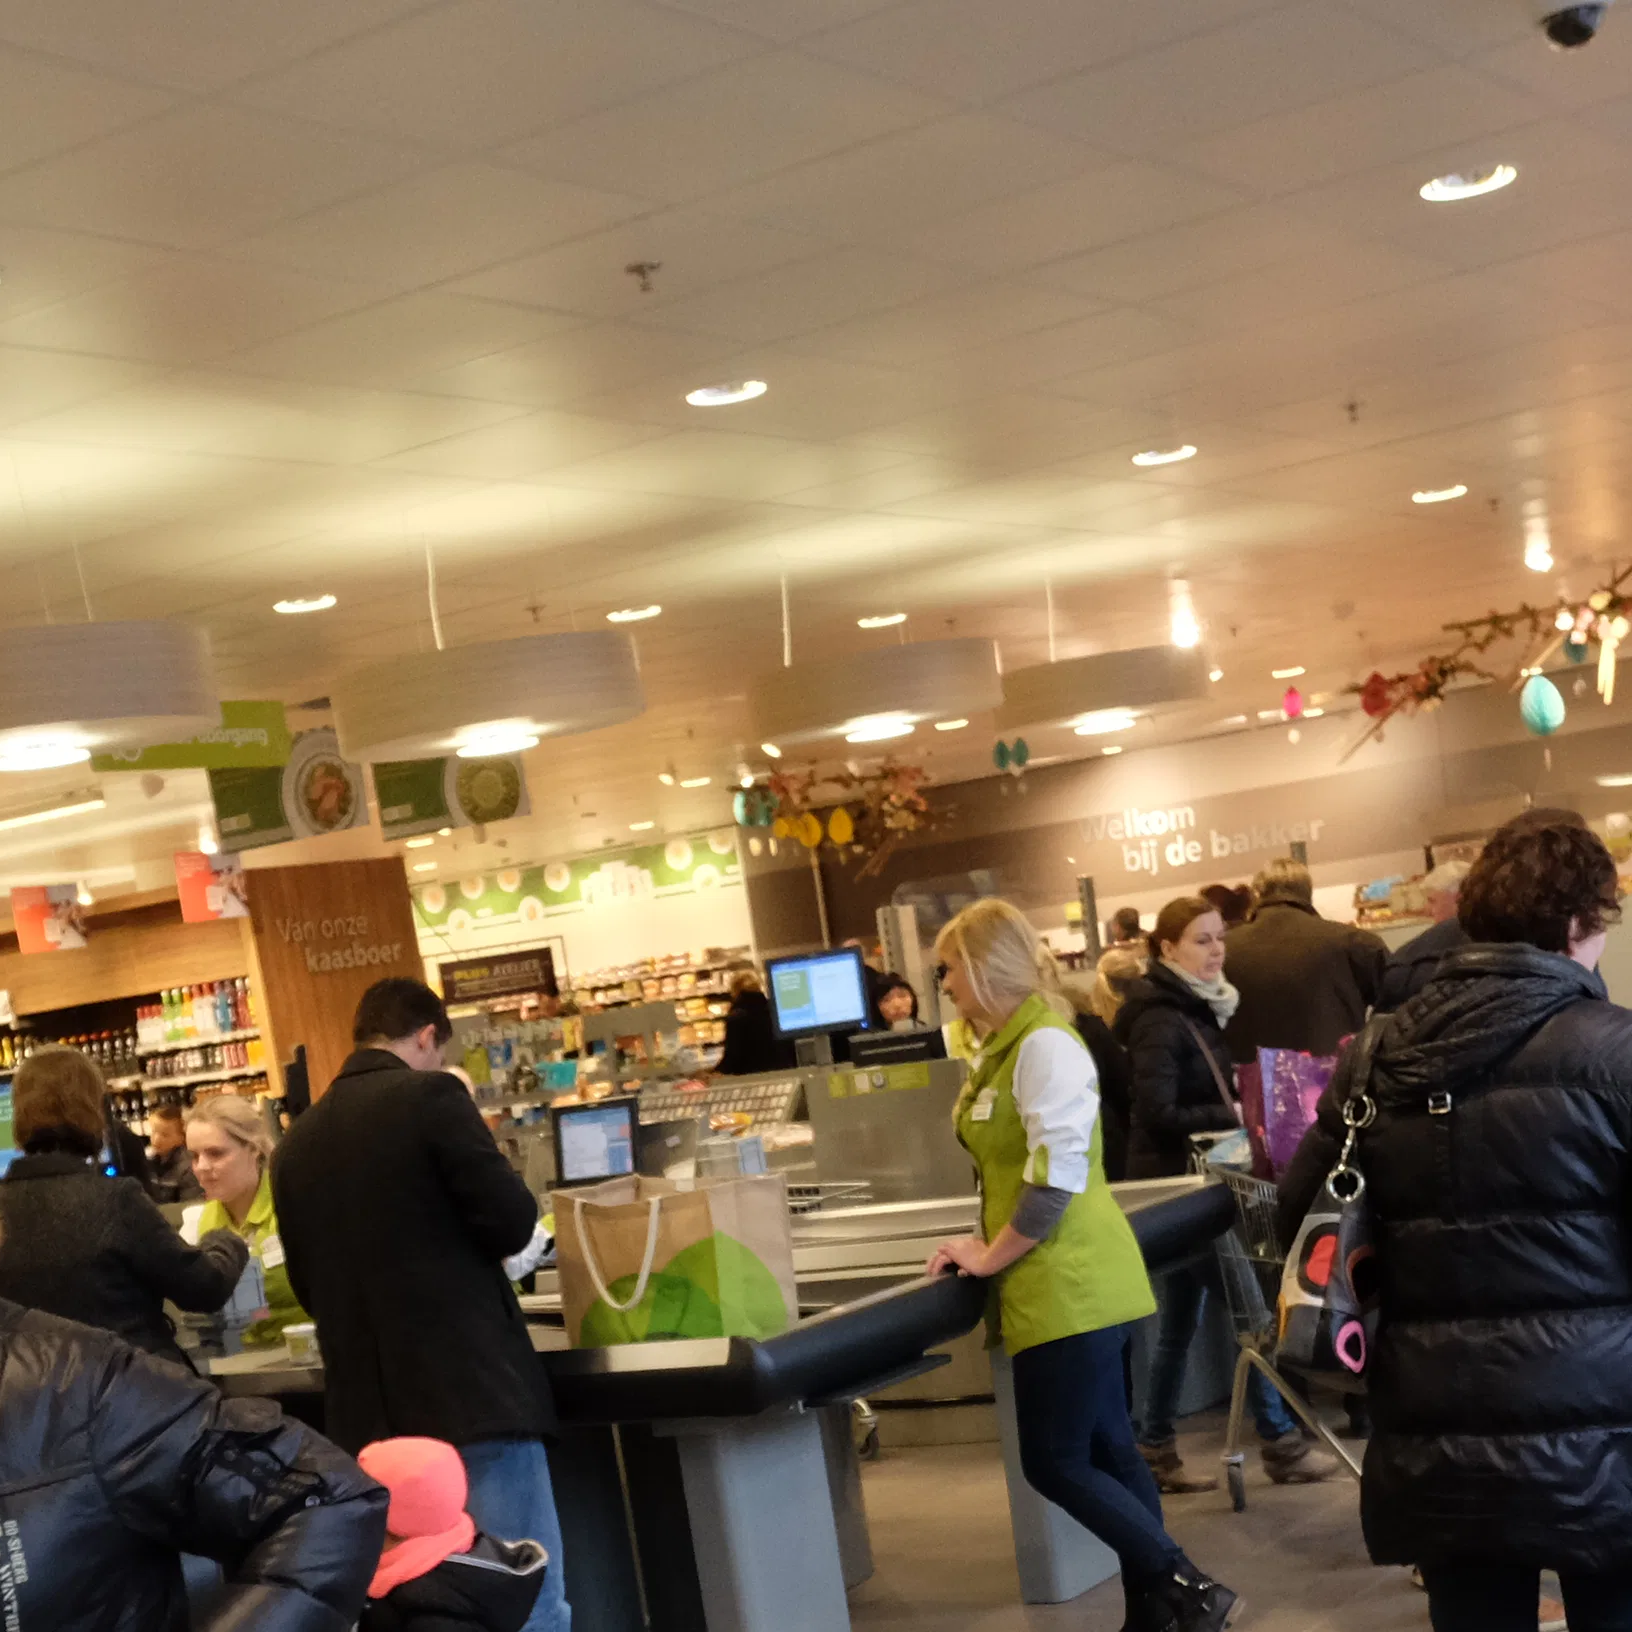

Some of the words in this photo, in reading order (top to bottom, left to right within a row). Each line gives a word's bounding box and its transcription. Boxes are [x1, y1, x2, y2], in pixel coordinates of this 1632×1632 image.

[1077, 806, 1196, 843] Welkom
[1121, 838, 1161, 877] bij
[1165, 834, 1204, 867] de
[1208, 819, 1325, 859] bakker
[275, 916, 317, 943] Van
[321, 913, 369, 938] onze
[303, 940, 402, 973] kaasboer
